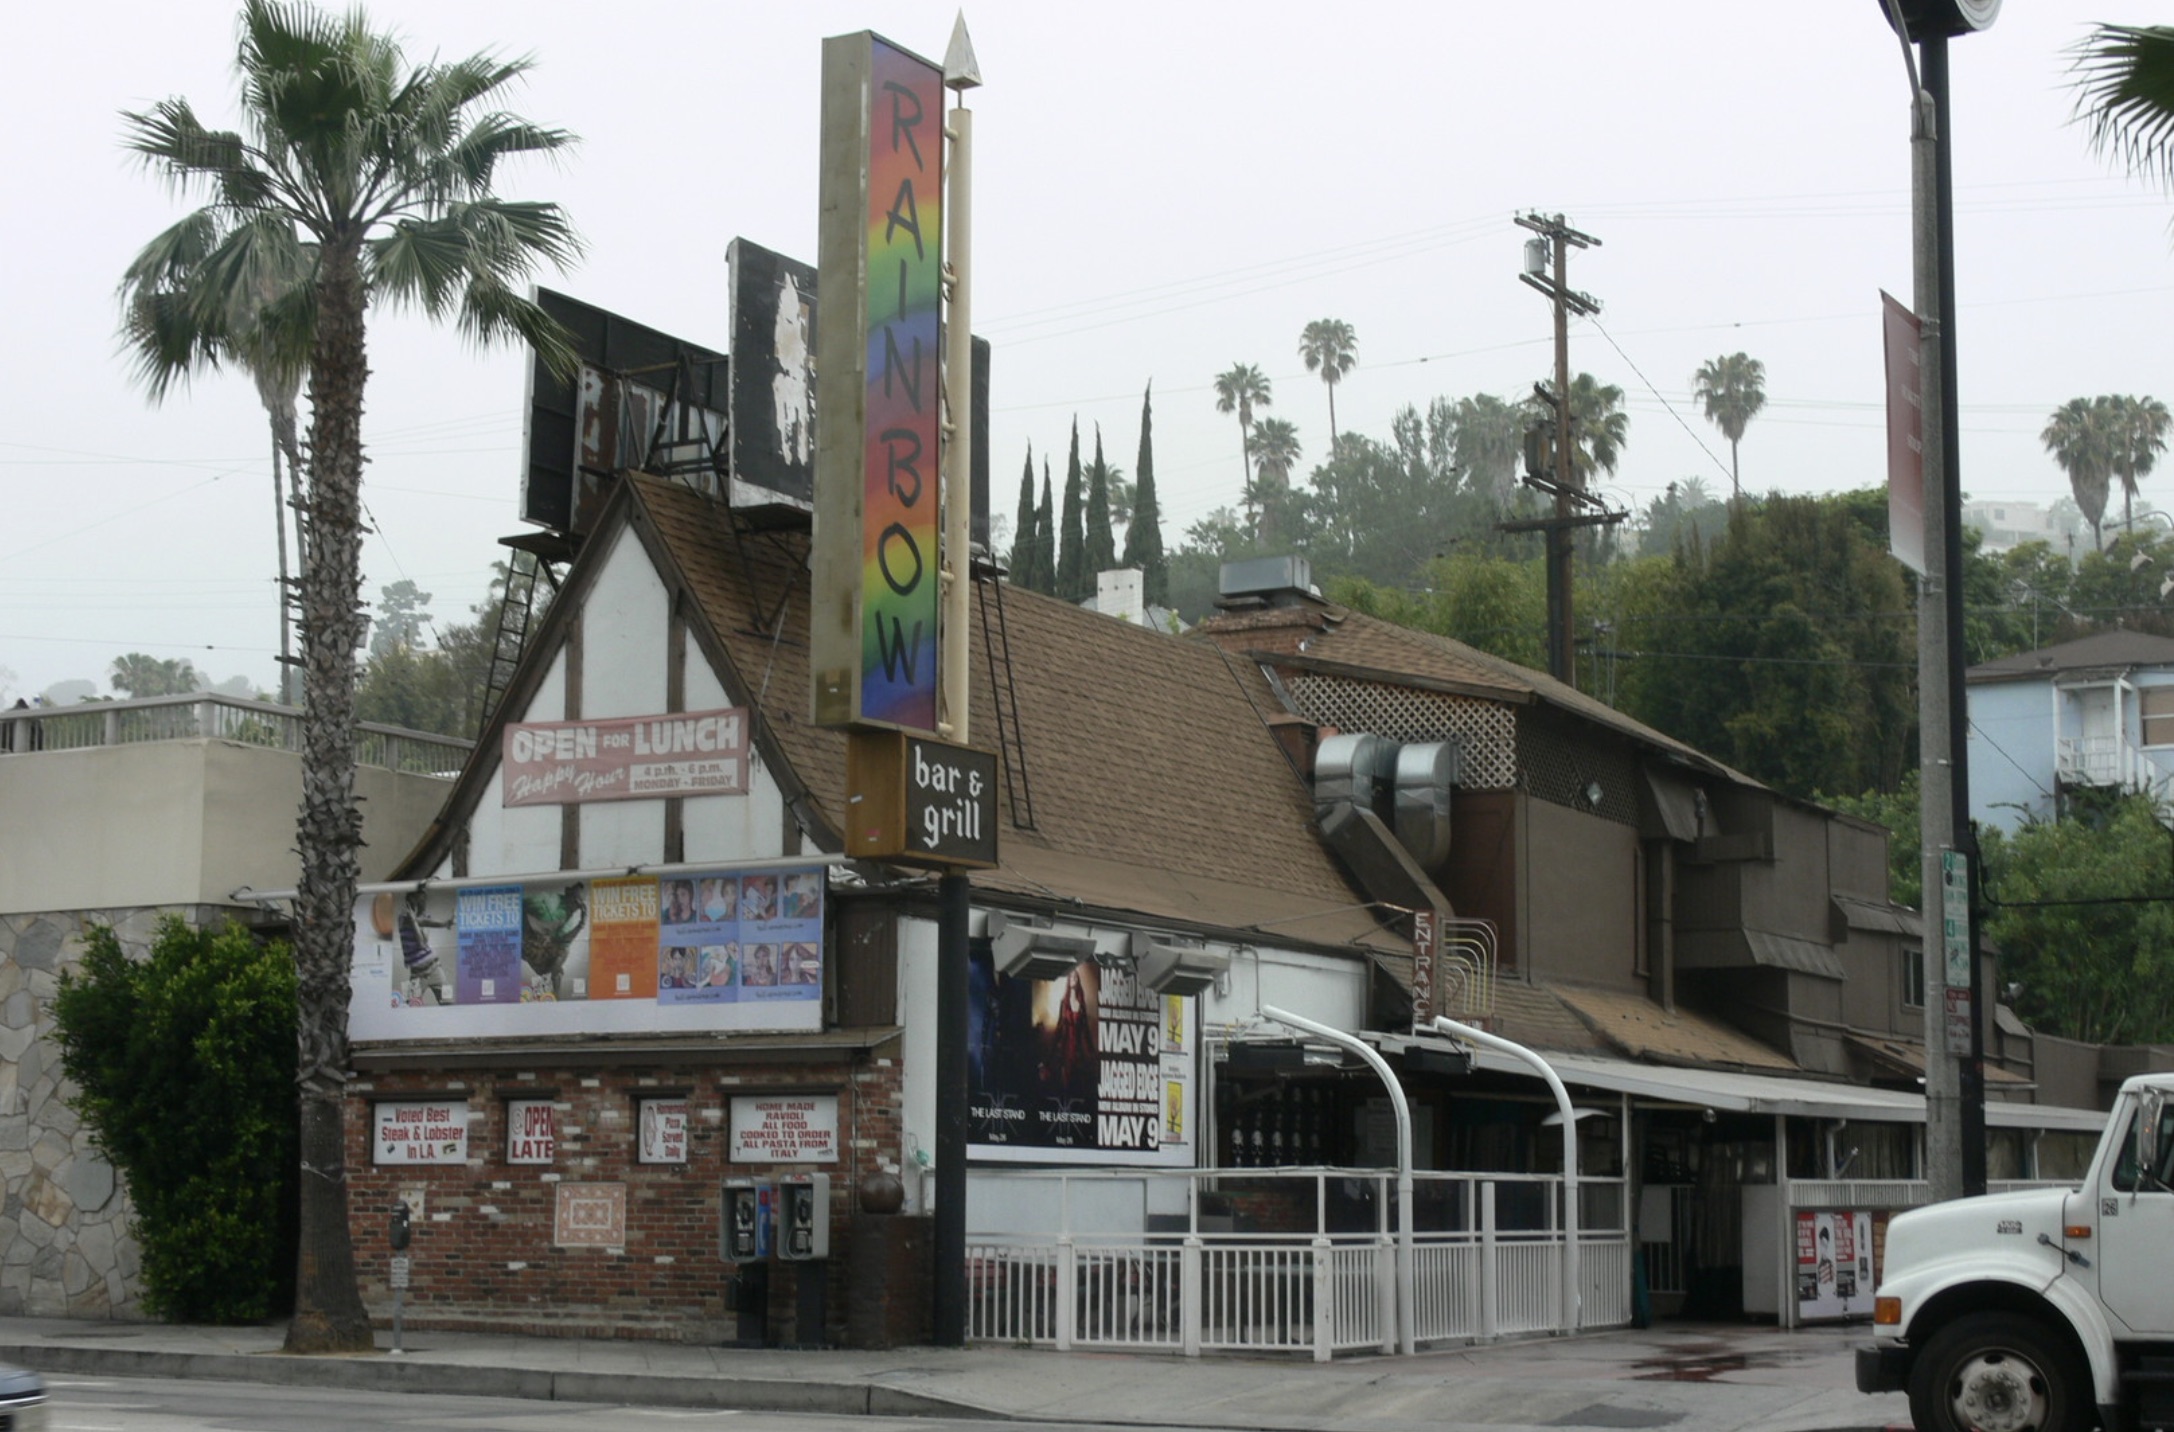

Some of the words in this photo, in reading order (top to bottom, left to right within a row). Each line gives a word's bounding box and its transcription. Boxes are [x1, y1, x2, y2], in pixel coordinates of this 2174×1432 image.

[876, 79, 925, 686] RAINBOW
[512, 727, 597, 763] OPEN
[603, 732, 630, 749] FOR
[634, 716, 740, 756] LUNCH
[914, 745, 961, 795] bar
[512, 764, 577, 799] Happy
[575, 767, 627, 796] Hour
[634, 779, 681, 790] MONDAY
[691, 775, 733, 787] FRIDAY
[923, 799, 981, 849] grill
[459, 895, 486, 913] WIN
[487, 893, 520, 911] FREE
[594, 886, 620, 904] WIN
[621, 884, 657, 903] FREE
[459, 911, 503, 928] TICKETS
[504, 909, 520, 925] TO
[593, 903, 639, 921] TICKETS
[640, 902, 657, 918] TO
[1413, 912, 1431, 1026] ENTRANCE
[1098, 1020, 1146, 1055] MAY
[1147, 1025, 1159, 1057] 9
[1098, 1060, 1136, 1099] JAGGED
[395, 1107, 424, 1122] Voted
[426, 1107, 450, 1122] Best
[755, 1102, 783, 1111] HOME
[786, 1102, 816, 1111] MADE
[970, 1106, 984, 1119] THE
[986, 1107, 1002, 1119] LAST
[1003, 1109, 1027, 1121] STAND
[524, 1106, 554, 1137] OPEN
[762, 1121, 780, 1130] ALL
[782, 1121, 808, 1130] FOOD
[765, 1112, 805, 1121] RAVIOLI
[1038, 1110, 1052, 1122] THE
[1053, 1111, 1068, 1123] LAST
[1069, 1112, 1092, 1124] STAND
[382, 1126, 410, 1142] Steak
[413, 1125, 421, 1141] &
[424, 1126, 464, 1141] Lobster
[740, 1131, 779, 1140] COOKED
[782, 1131, 795, 1140] TO
[797, 1131, 832, 1140] ORDER
[1097, 1114, 1145, 1147] MAY
[1146, 1117, 1159, 1149] 9
[407, 1144, 417, 1159] In
[511, 1140, 554, 1159] LATE
[742, 1140, 759, 1149] ALL
[762, 1140, 797, 1149] PASTA
[799, 1140, 829, 1149] FROM
[771, 1150, 800, 1159] ITALY
